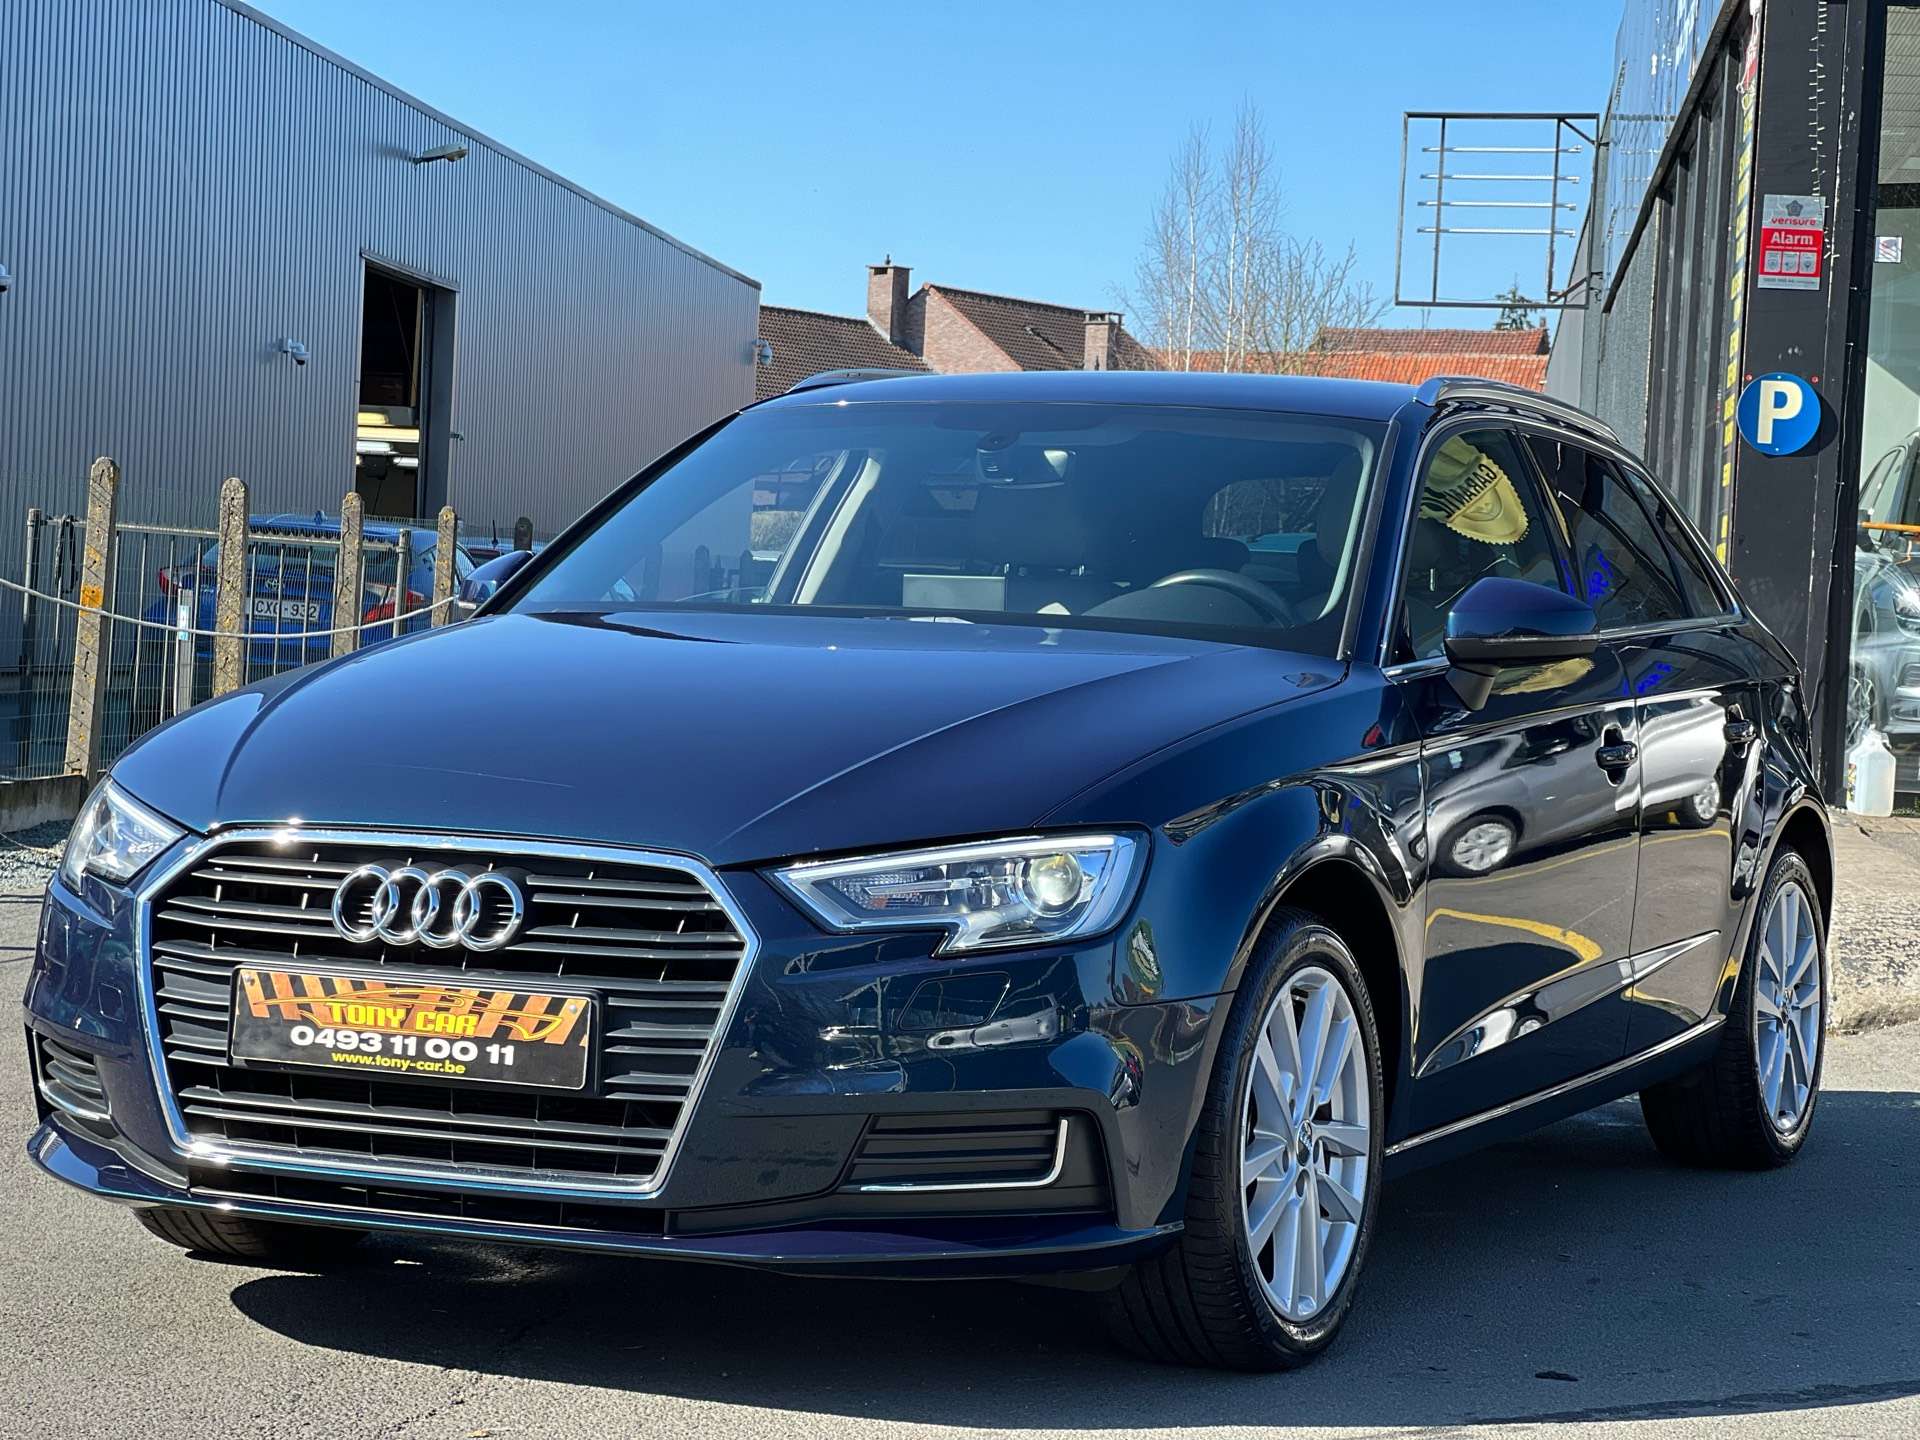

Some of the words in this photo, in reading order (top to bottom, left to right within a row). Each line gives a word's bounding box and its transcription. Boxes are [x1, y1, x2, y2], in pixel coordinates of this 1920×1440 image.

[1771, 217, 1816, 226] verisure
[1771, 231, 1813, 245] Alarm
[1757, 380, 1803, 444] P
[324, 1002, 405, 1028] TONY
[415, 1011, 478, 1036] CAR
[290, 1025, 382, 1052] 0493
[390, 1035, 422, 1056] 11
[424, 1038, 479, 1062] 00
[486, 1044, 515, 1066] 11
[331, 1052, 466, 1074] www.tony-car.be
